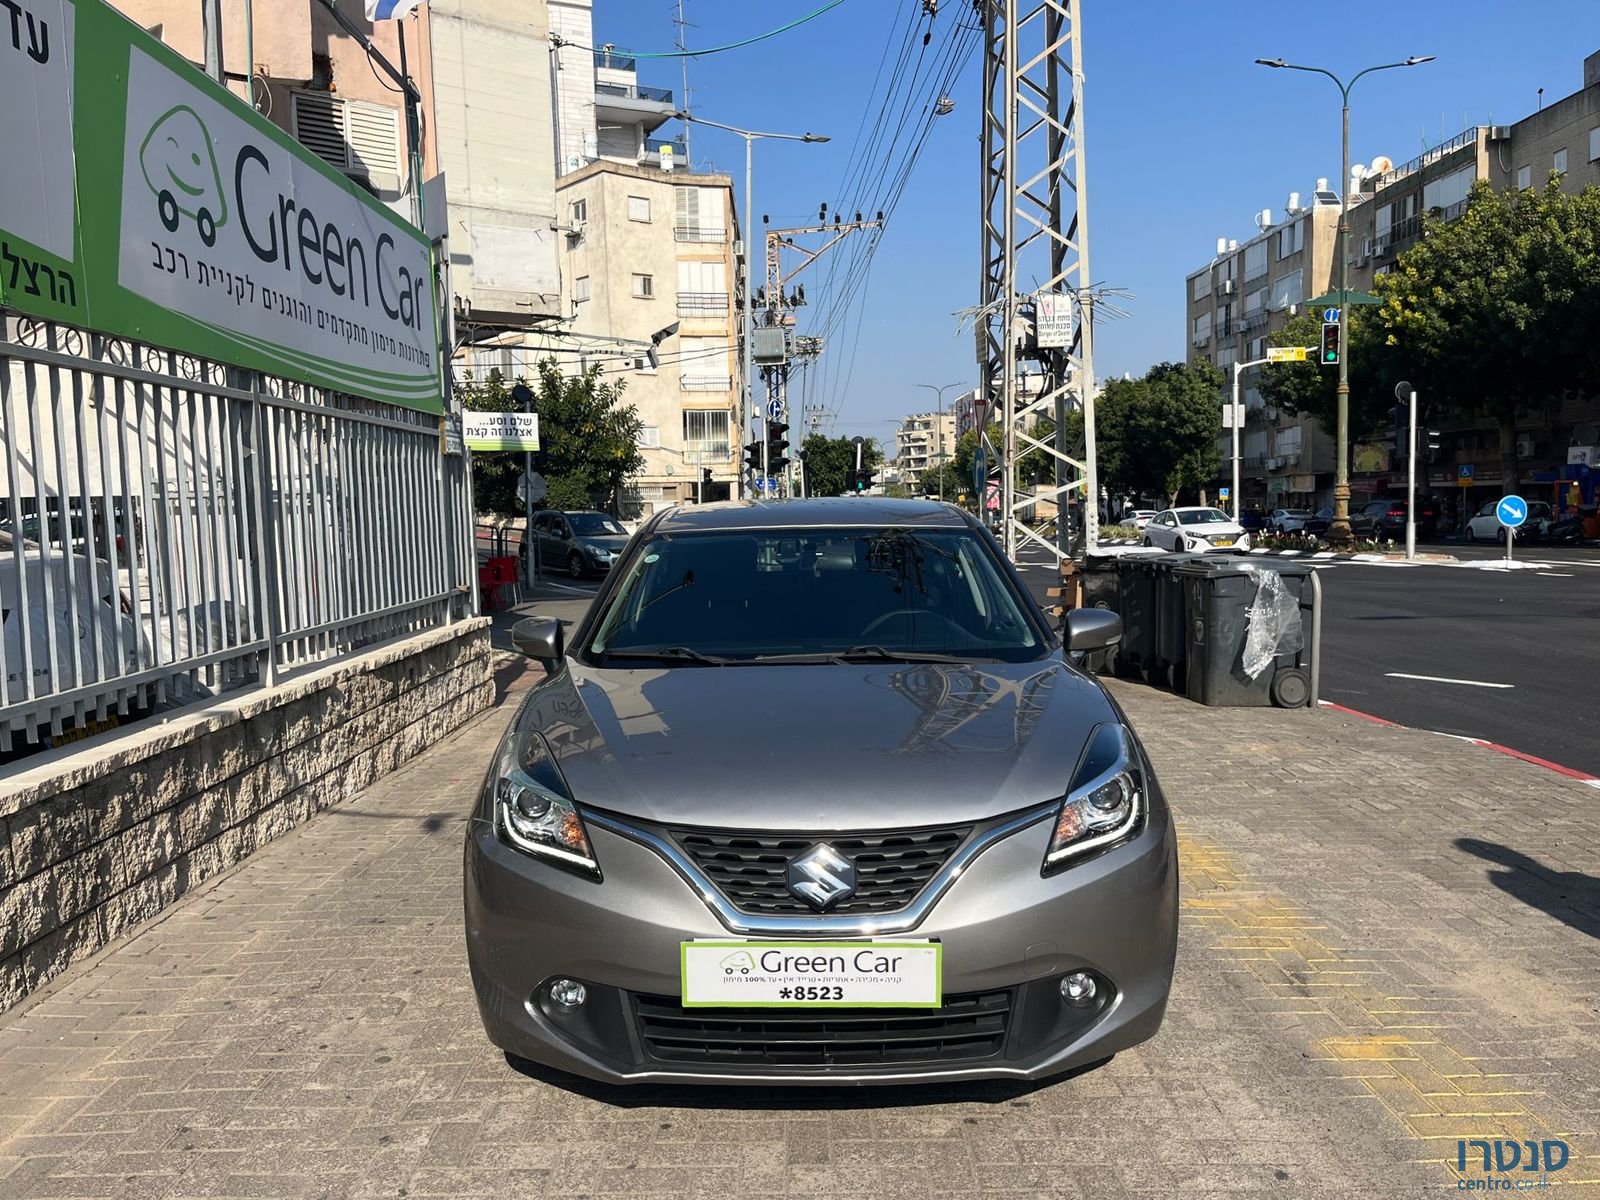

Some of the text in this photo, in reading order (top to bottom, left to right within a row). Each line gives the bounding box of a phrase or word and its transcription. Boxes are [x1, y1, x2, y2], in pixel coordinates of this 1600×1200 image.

[235, 145, 423, 331] Green Car
[152, 242, 430, 368] פתרונות מימון מתקדמים והוגנים לקניית רכב
[510, 416, 532, 426] שלם
[466, 427, 533, 438] אצלנו זה קצת
[761, 951, 902, 973] Green Car
